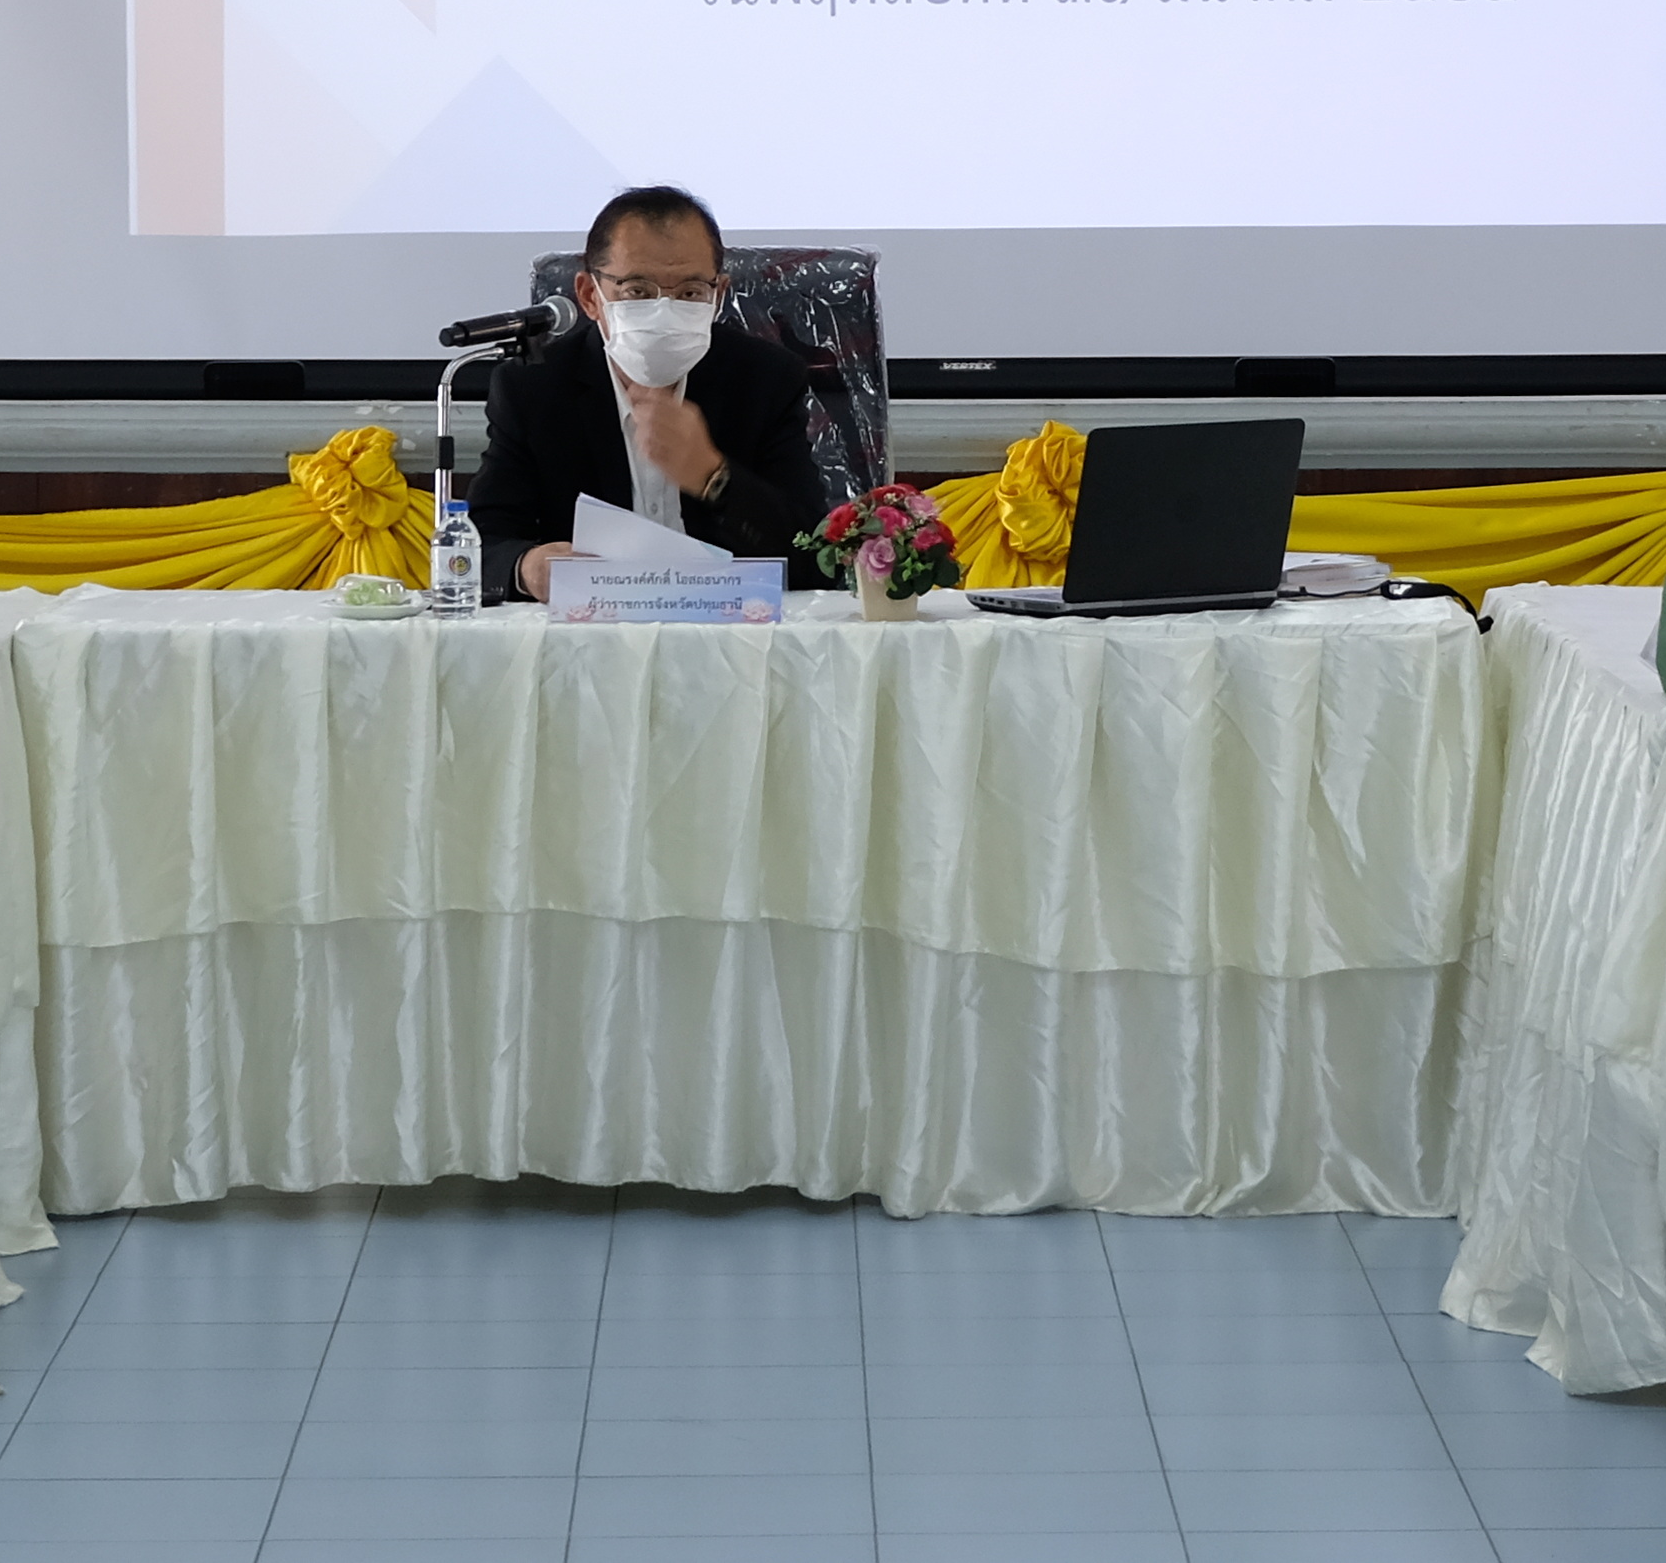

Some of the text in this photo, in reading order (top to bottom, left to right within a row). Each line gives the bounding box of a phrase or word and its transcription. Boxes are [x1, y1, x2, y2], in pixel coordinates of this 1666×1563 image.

[588, 597, 743, 614] ผู้ว่าราชการจังหวัดปทุมธานี
